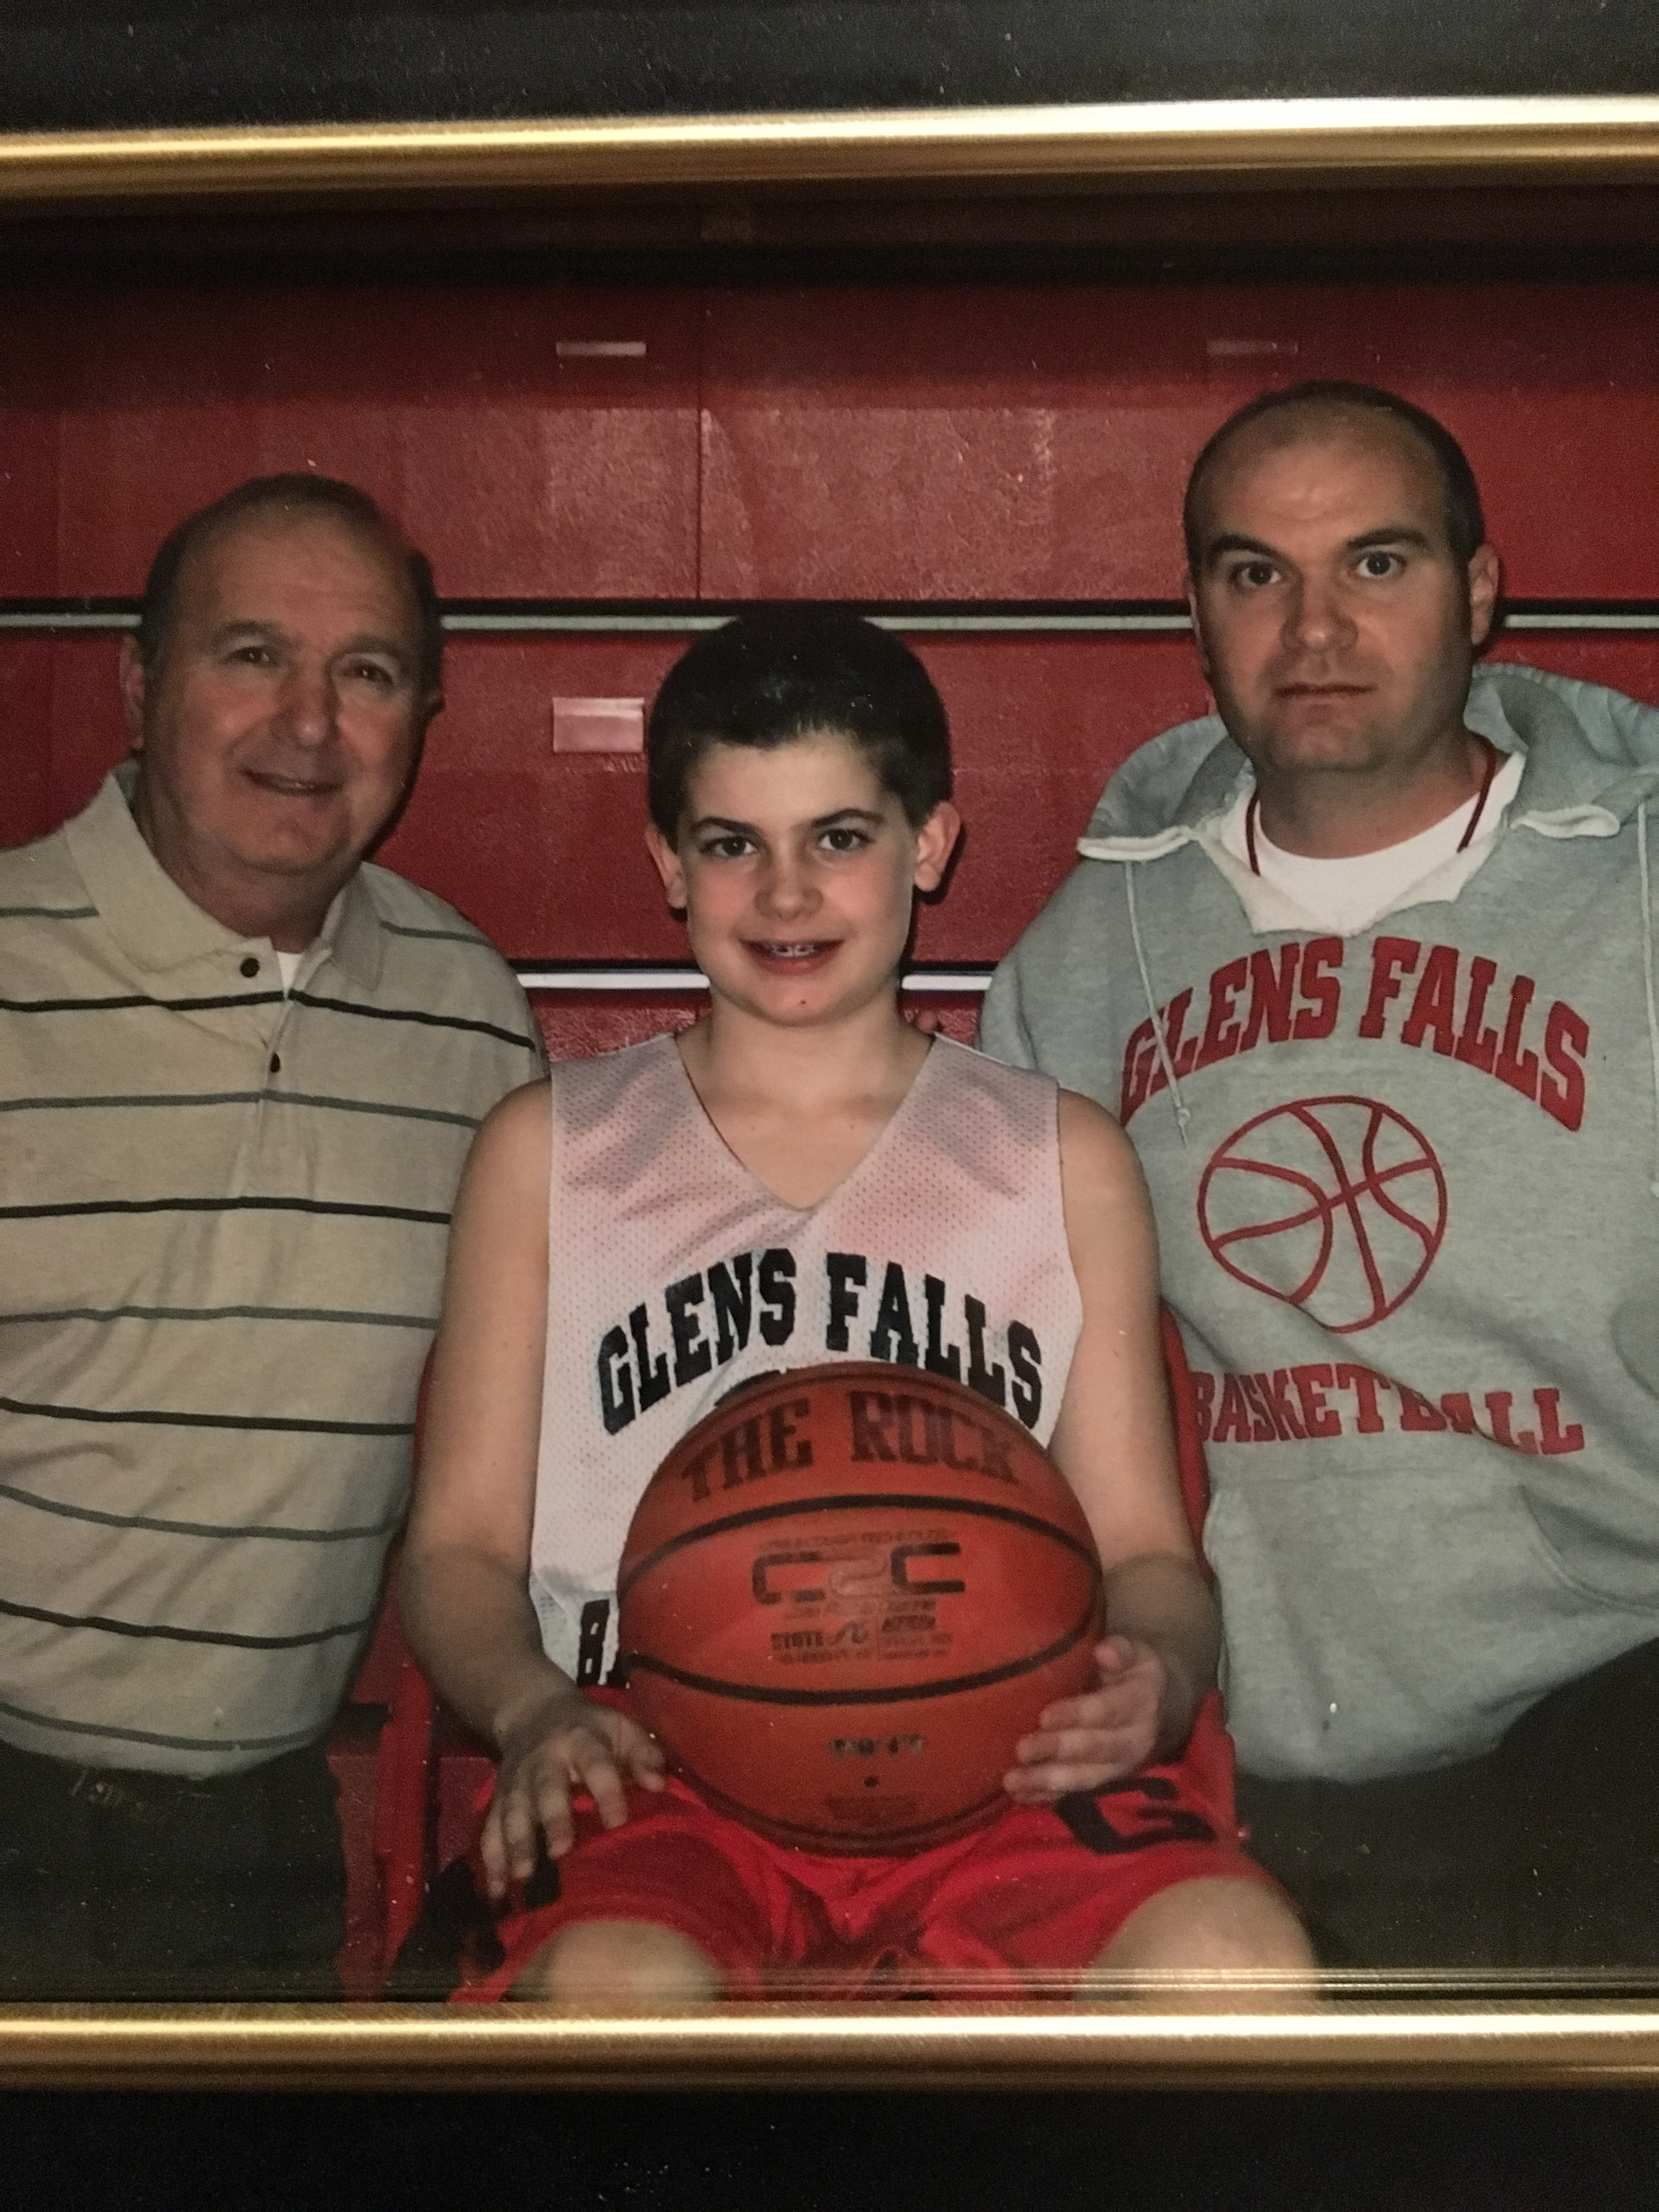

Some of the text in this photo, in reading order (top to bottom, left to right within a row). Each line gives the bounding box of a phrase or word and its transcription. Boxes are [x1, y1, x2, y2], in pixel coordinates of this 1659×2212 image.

[1120, 935, 1590, 1133] GLENS FALLS
[597, 1248, 1042, 1435] GLENS FALLS
[681, 1390, 1019, 1502] THE ROCK
